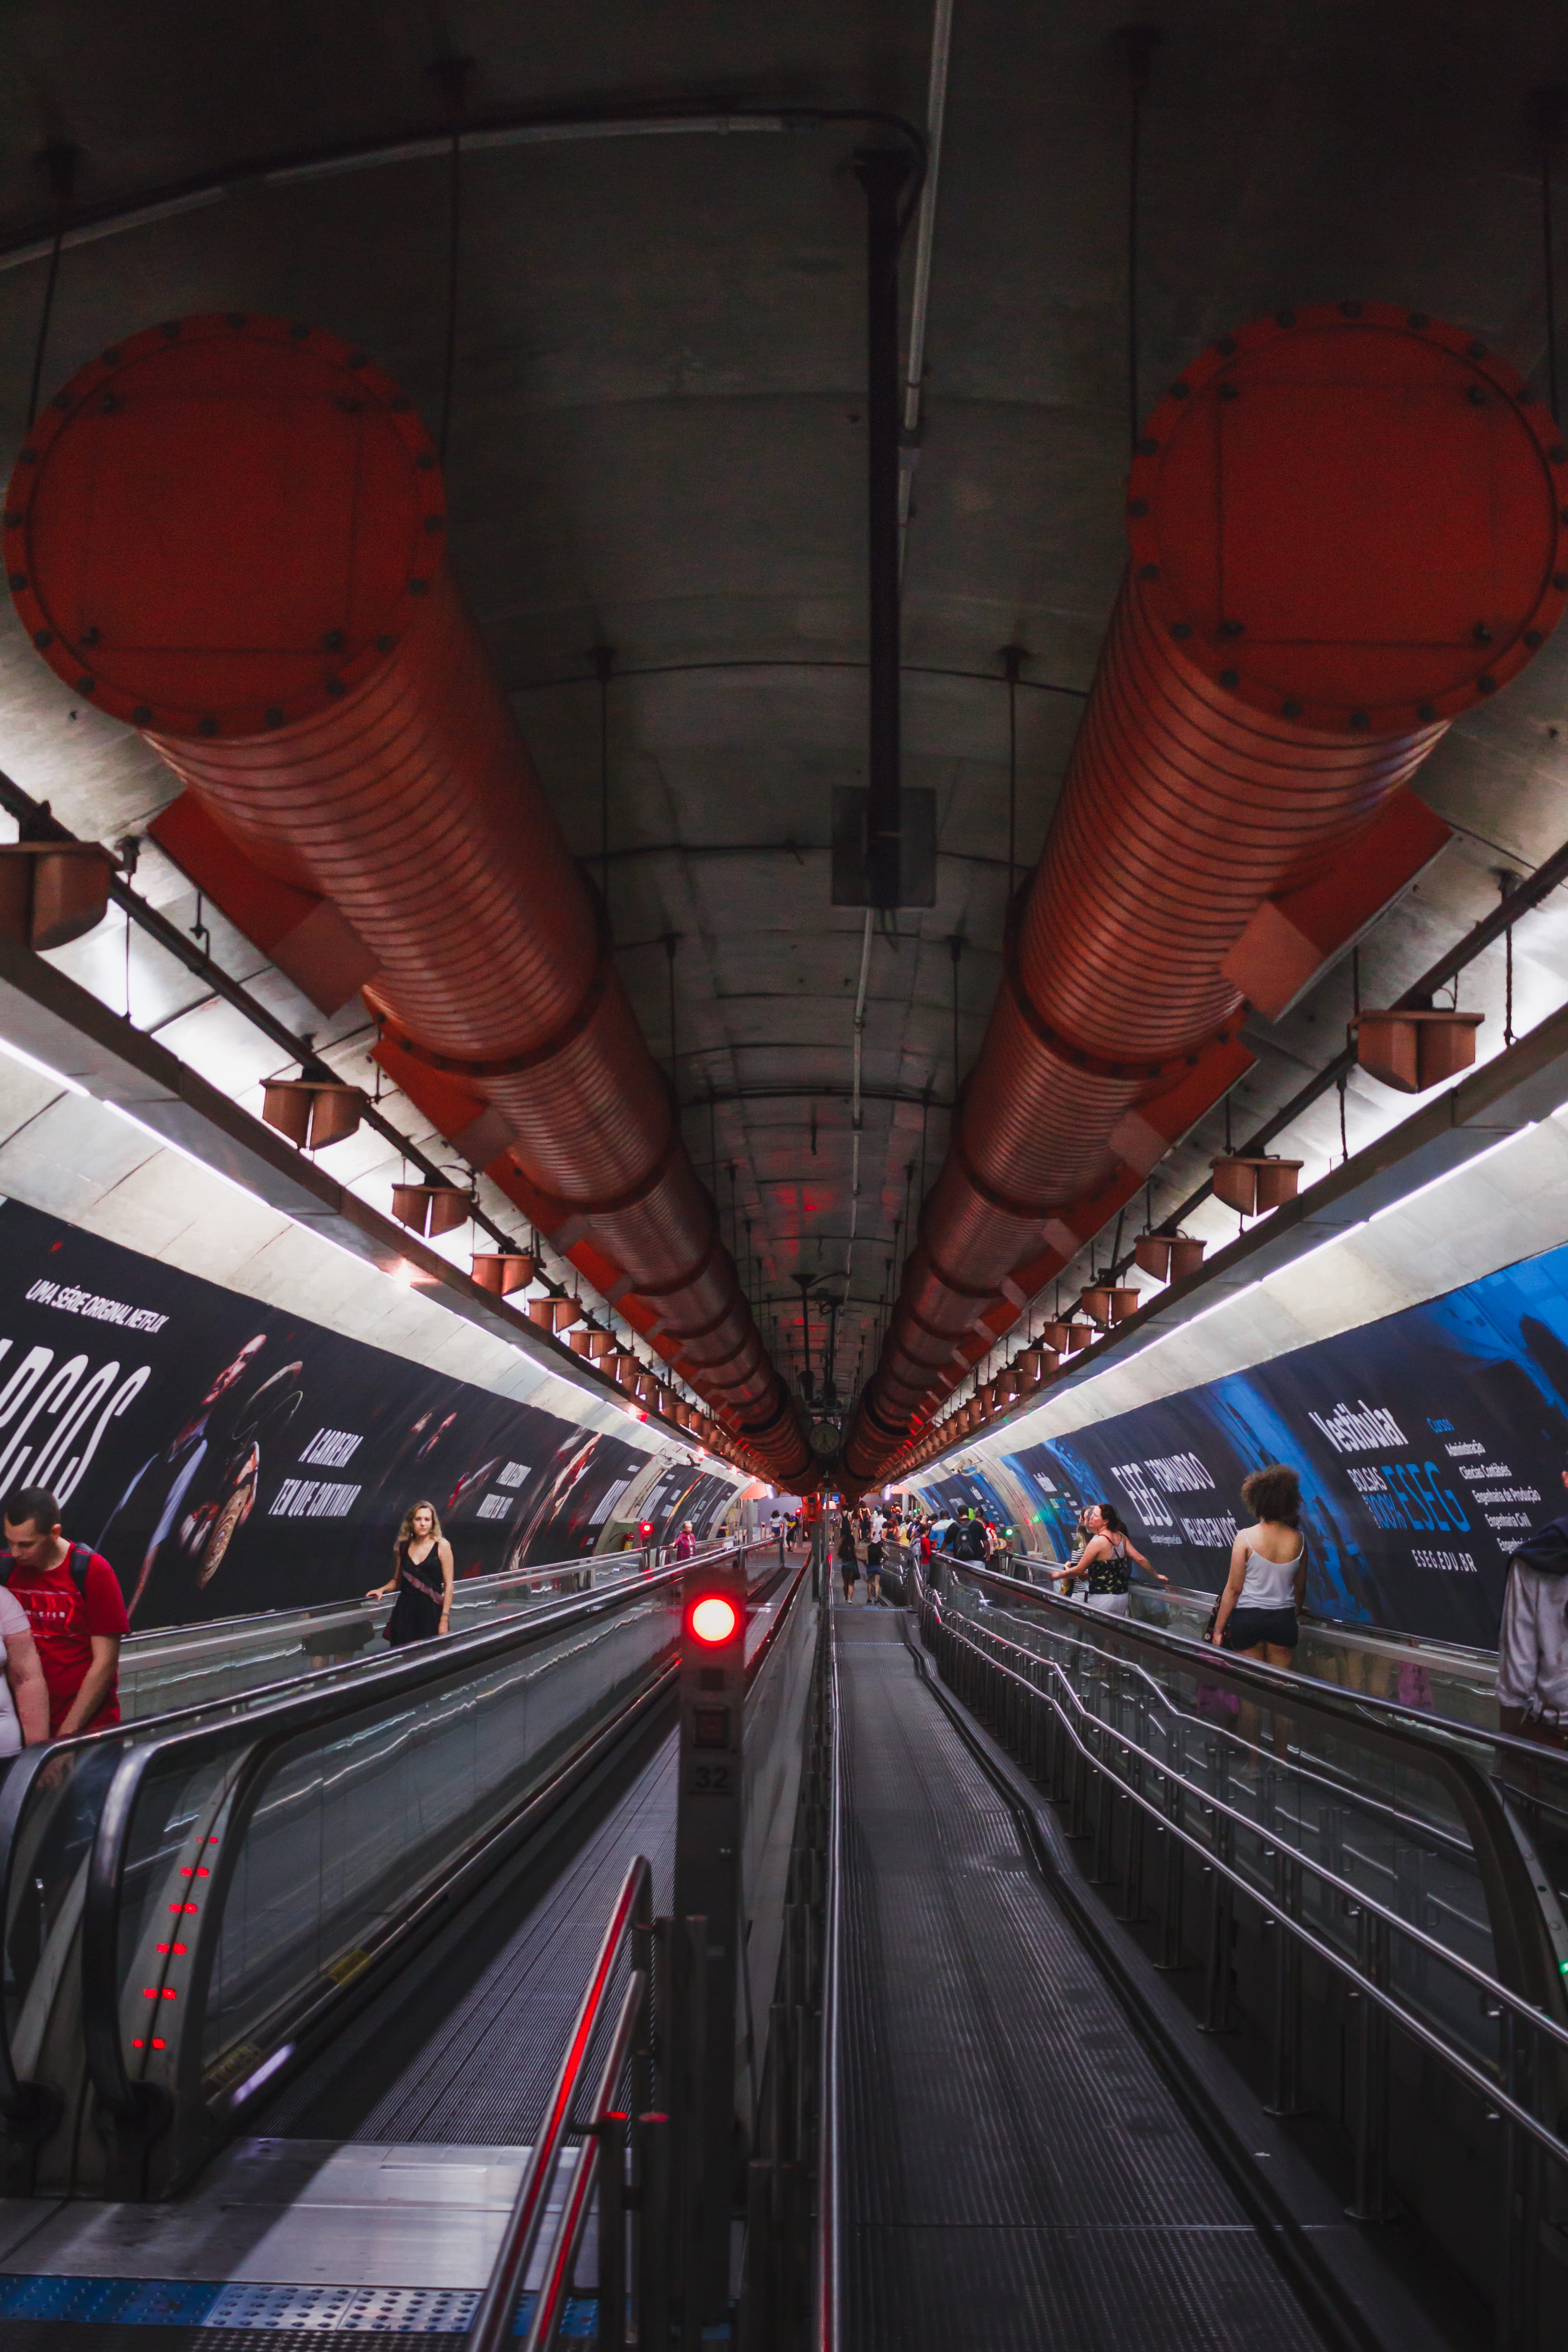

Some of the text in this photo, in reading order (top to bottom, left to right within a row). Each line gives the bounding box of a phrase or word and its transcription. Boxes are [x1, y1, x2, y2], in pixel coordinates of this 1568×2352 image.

[25, 1279, 170, 1333] UMA SÉRIE ORIGINAL NETFLIX
[1308, 1399, 1409, 1453] Vestibular
[1426, 1417, 1455, 1433] Cursos
[298, 1428, 364, 1468] A CARREIRA
[1445, 1439, 1486, 1457] Administração
[1144, 1452, 1215, 1493] FORMANDO O
[1346, 1466, 1388, 1492] BOLSAS
[1458, 1462, 1512, 1480] Ciências Contábeis
[268, 1479, 362, 1517] TEM QUE CONTINUAR
[1110, 1463, 1173, 1527] ESEG
[1380, 1461, 1471, 1532] ESEG
[1471, 1486, 1542, 1506] Engenharia de Produção
[1364, 1493, 1407, 1529] 100%
[1484, 1512, 1532, 1529] Engenharia Civil
[1411, 1549, 1477, 1572] ESEG.EDU.BR
[696, 1767, 728, 1788] 32
